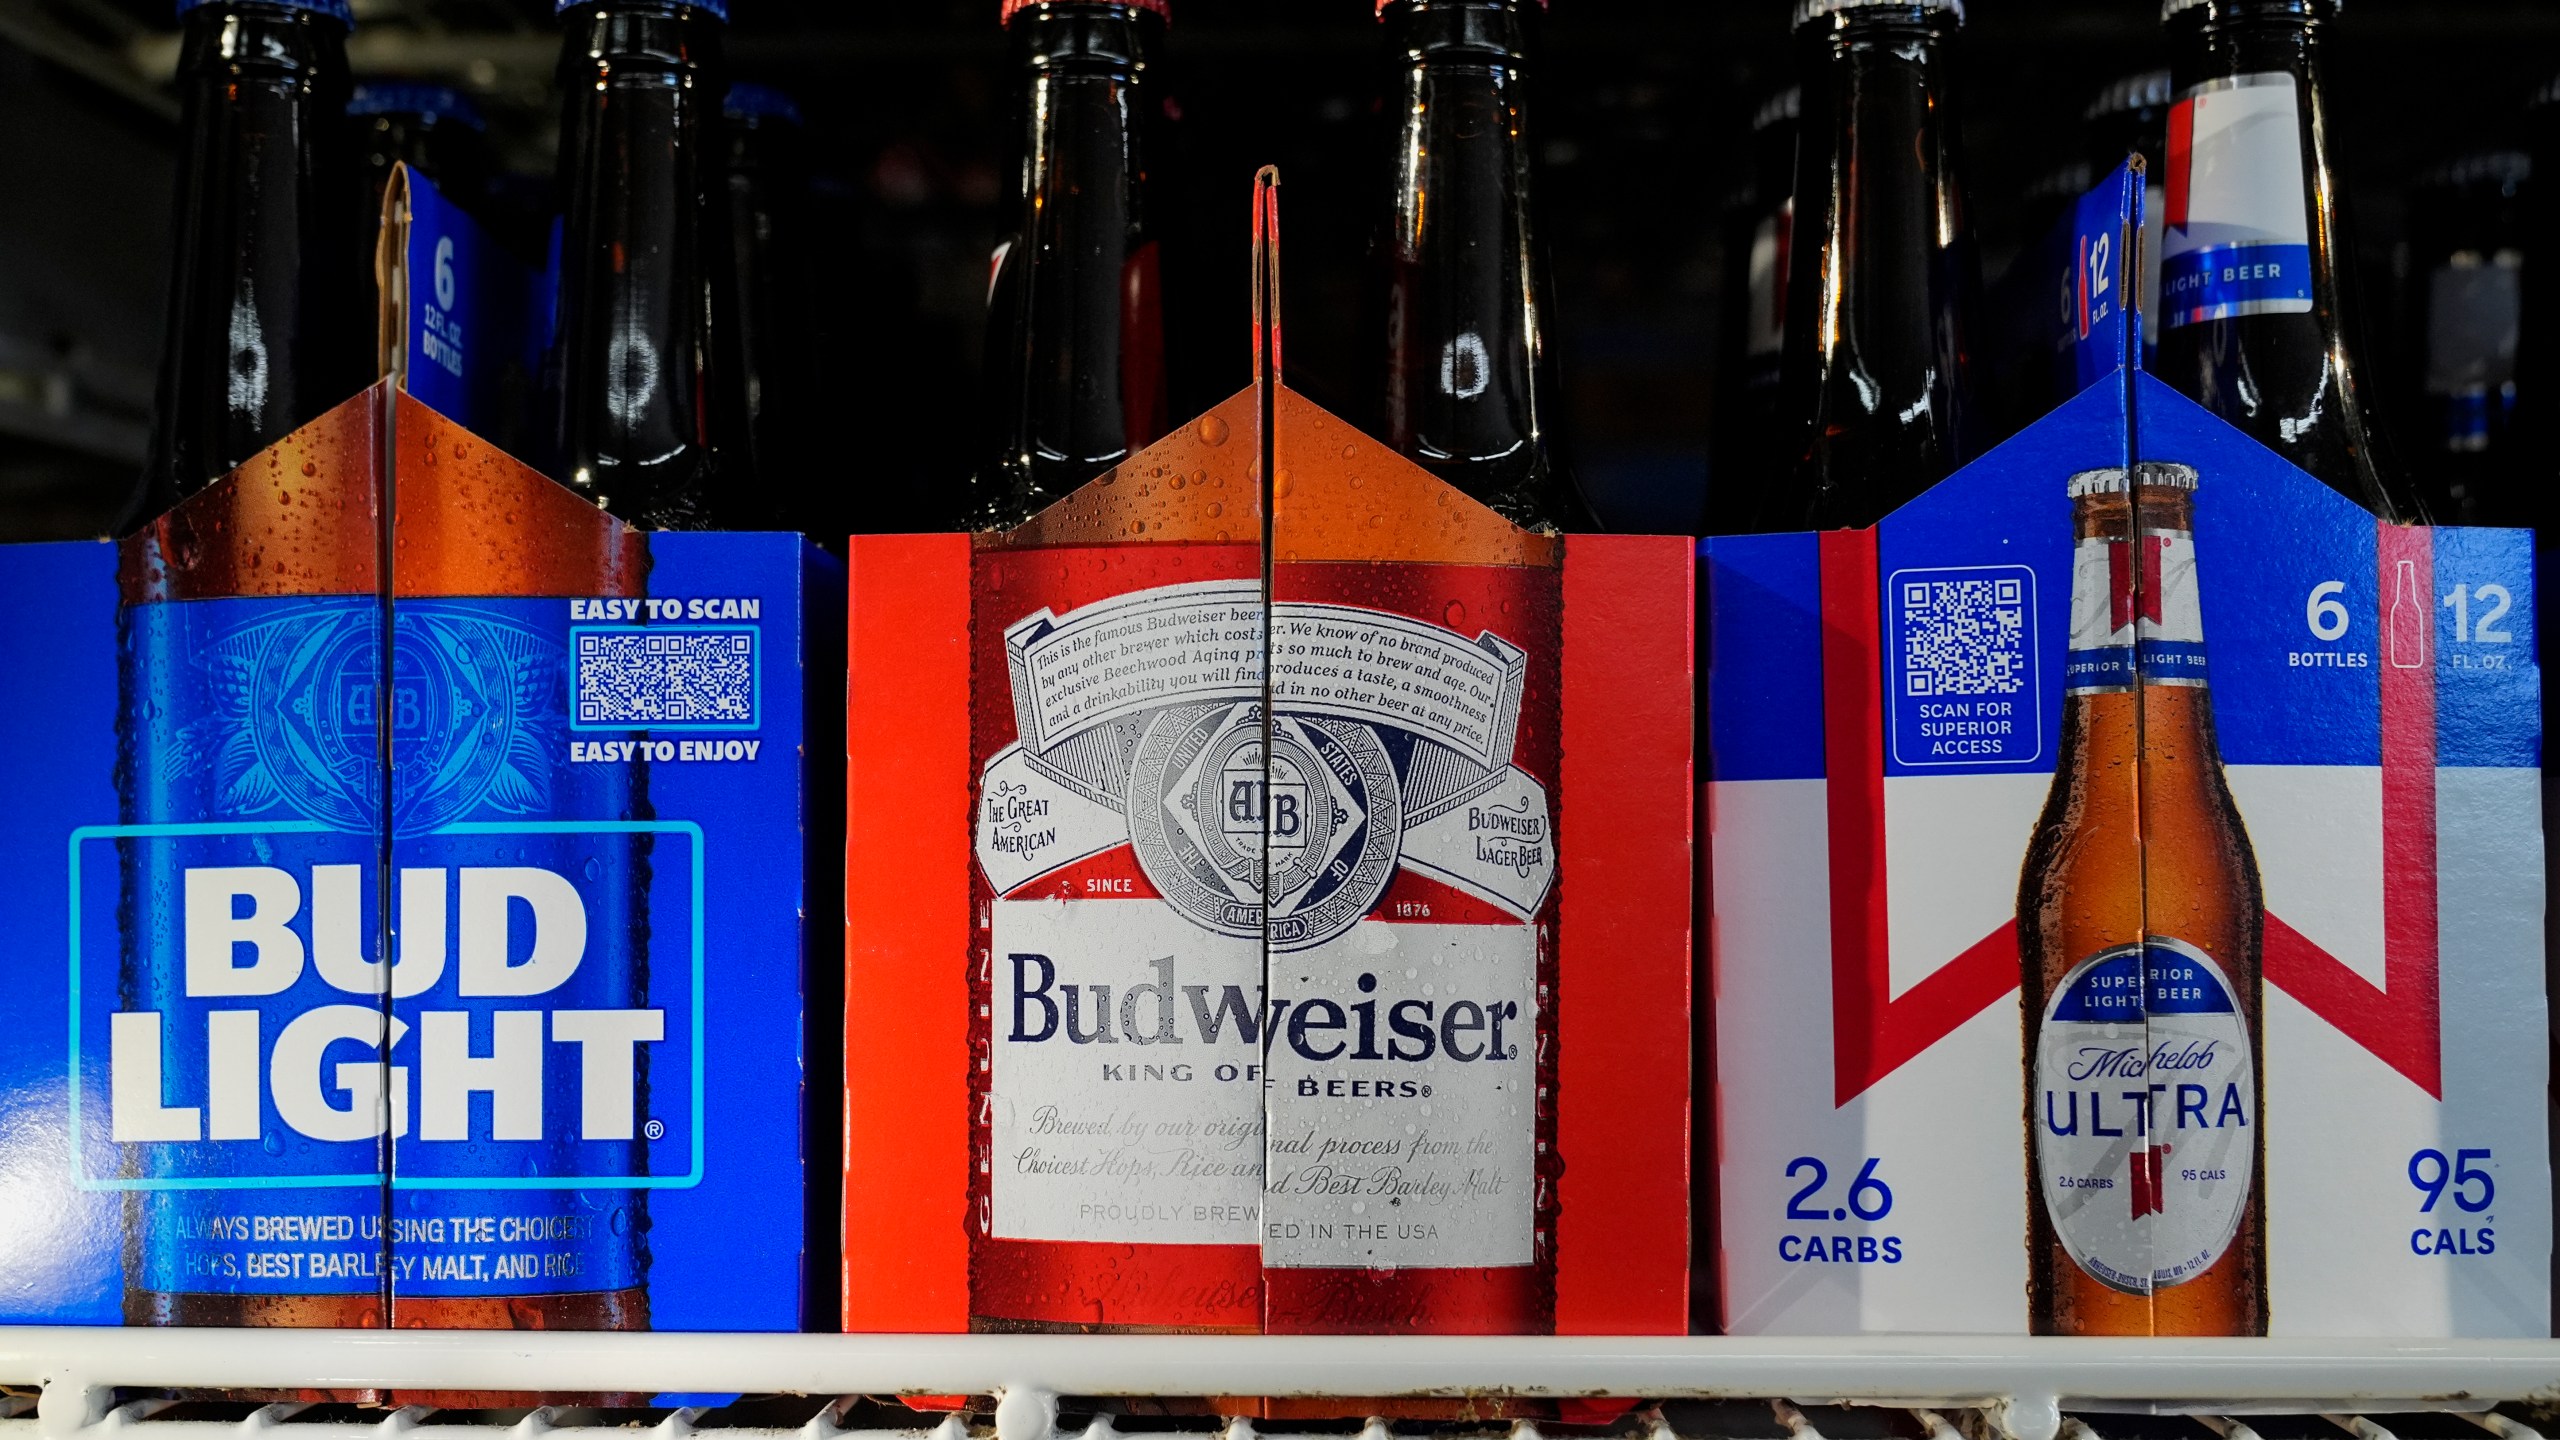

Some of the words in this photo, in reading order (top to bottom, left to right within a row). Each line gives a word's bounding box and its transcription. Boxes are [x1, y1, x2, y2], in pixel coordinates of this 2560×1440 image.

[434, 235, 455, 313] 6
[2089, 232, 2110, 299] 12
[2165, 271, 2211, 297] LIGHT
[2223, 263, 2281, 283] BEER
[2060, 265, 2071, 325] 6
[425, 303, 436, 330] 12
[423, 329, 463, 378] BOTTLES
[570, 599, 640, 620] EASY
[645, 599, 683, 619] TO
[688, 598, 760, 619] SCAN
[2307, 580, 2349, 642] 6
[2443, 583, 2512, 643] 12
[1036, 652, 1058, 671] This
[1061, 645, 1071, 657] is
[1073, 636, 1091, 652] the
[1094, 620, 1143, 648] famous
[1147, 610, 1227, 631] Budweiser
[1290, 622, 1312, 636] We
[1316, 624, 1358, 640] know
[1360, 630, 1377, 645] of
[1379, 635, 1396, 648] no
[1400, 640, 1441, 660] brand
[1442, 651, 1495, 686] produced
[2187, 655, 2206, 666] BEER
[2288, 651, 2368, 668] BOTTLES
[2452, 654, 2478, 669] FL.
[2482, 654, 2512, 670] OZ.
[1041, 676, 1056, 690] by
[1058, 663, 1079, 682] any
[1082, 650, 1116, 670] other
[1120, 637, 1169, 657] brewer
[1174, 631, 1219, 648] which
[1288, 644, 1306, 656] so
[1310, 643, 1352, 660] much
[1357, 646, 1372, 663] to
[1377, 651, 1413, 672] brew
[1415, 664, 1440, 682] and
[1443, 675, 1467, 694] age.
[1470, 685, 1491, 704] Our
[1045, 676, 1100, 708] exclusive
[1104, 654, 1187, 682] Beechwood
[1192, 649, 1239, 665] Aging
[1343, 669, 1353, 680] a
[1357, 671, 1398, 692] taste,
[1401, 681, 1411, 692] a
[1413, 684, 1488, 724] smoothness
[1049, 711, 1071, 727] and
[1073, 705, 1082, 714] a
[1084, 678, 1166, 710] drinkability
[1170, 674, 1199, 689] you
[1202, 667, 1231, 682] will
[1291, 682, 1306, 695] in
[1311, 686, 1330, 698] no
[1334, 684, 1376, 705] other
[1377, 693, 1409, 712] beer
[1411, 705, 1427, 717] at
[1428, 710, 1453, 729] any
[1452, 720, 1484, 745] price.
[1919, 703, 1970, 719] SCAN
[1976, 702, 2012, 716] FOR
[1921, 721, 2012, 737] SUPERIOR
[570, 741, 636, 763] EASY
[639, 741, 675, 762] TO
[679, 740, 760, 761] ENJOY
[1171, 727, 1209, 770] UNITED
[1320, 741, 1358, 787] STATES
[1931, 739, 2003, 755] ACCESS
[1182, 841, 1199, 871] THE
[1235, 836, 1256, 855] TRADE
[1275, 851, 1294, 868] MARK
[1086, 878, 1133, 893] SINCE
[1331, 859, 1348, 882] OF
[1226, 904, 1303, 939] AMERICA
[1396, 901, 1431, 917] 1876
[184, 865, 587, 1000] BUD
[2091, 968, 2193, 988] SUPERIOR
[1007, 951, 1517, 1063] Budweiser
[2085, 994, 2139, 1008] LIGHT
[2158, 988, 2202, 1000] BEER
[110, 1008, 665, 1143] LIGHT
[1103, 1063, 1193, 1083] KING
[2068, 1040, 2219, 1081] Michelob
[2047, 1082, 2247, 1137] ULTRA
[1030, 1105, 1111, 1137] Brewed
[1117, 1111, 1146, 1147] by
[1154, 1120, 1199, 1137] our
[1317, 1138, 1401, 1163] process
[1406, 1129, 1460, 1163] from
[1466, 1130, 1494, 1155] the
[1013, 1147, 1089, 1176] Choicest
[1090, 1149, 1156, 1184] Hops,
[1160, 1148, 1225, 1178] Rice
[1295, 1165, 1369, 1196] Best
[1366, 1166, 1452, 1206] Barley
[1452, 1169, 1509, 1200] Malt
[1785, 1156, 1893, 1222] 2.6
[2059, 1176, 2075, 1188] 2.6
[2077, 1178, 2114, 1189] CARBS
[2182, 1169, 2197, 1181] 95
[2200, 1169, 2226, 1181] CALS
[2408, 1148, 2495, 1213] 95
[176, 1216, 249, 1241] ALWAYS
[253, 1215, 354, 1242] BREWED
[449, 1217, 495, 1243] THE
[498, 1216, 595, 1242] CHOICEST
[1080, 1205, 1185, 1222] PROUDLY
[1310, 1224, 1334, 1239] IN
[1343, 1224, 1389, 1239] THE
[1397, 1224, 1440, 1239] USA
[1778, 1235, 1903, 1264] CARBS
[2411, 1228, 2496, 1256] CALS
[186, 1252, 241, 1280] HOPS,
[246, 1253, 302, 1279] BEST
[422, 1255, 489, 1282] MALT,
[494, 1254, 540, 1279] AND
[544, 1253, 584, 1277] RICE
